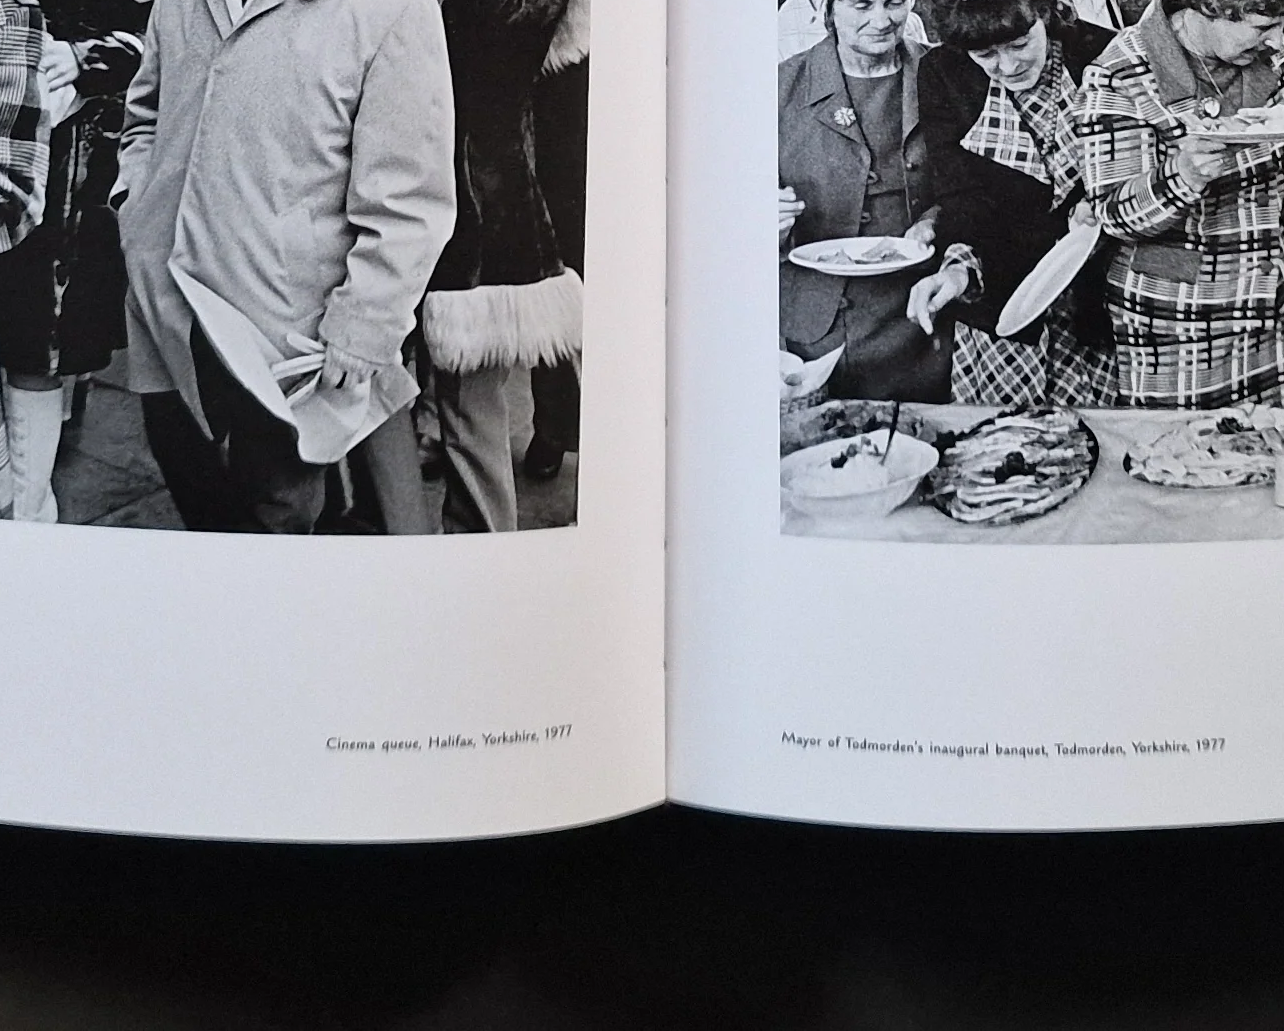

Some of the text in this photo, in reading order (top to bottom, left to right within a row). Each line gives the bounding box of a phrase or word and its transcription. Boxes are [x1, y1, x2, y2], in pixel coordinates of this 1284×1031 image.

[326, 724, 573, 753] Cinema queue, Halifax, Yorkshire, 1977
[781, 730, 1226, 759] Mayor of Todmorden's inaugural banquet, Todmorden, Yorkshire, 1977
